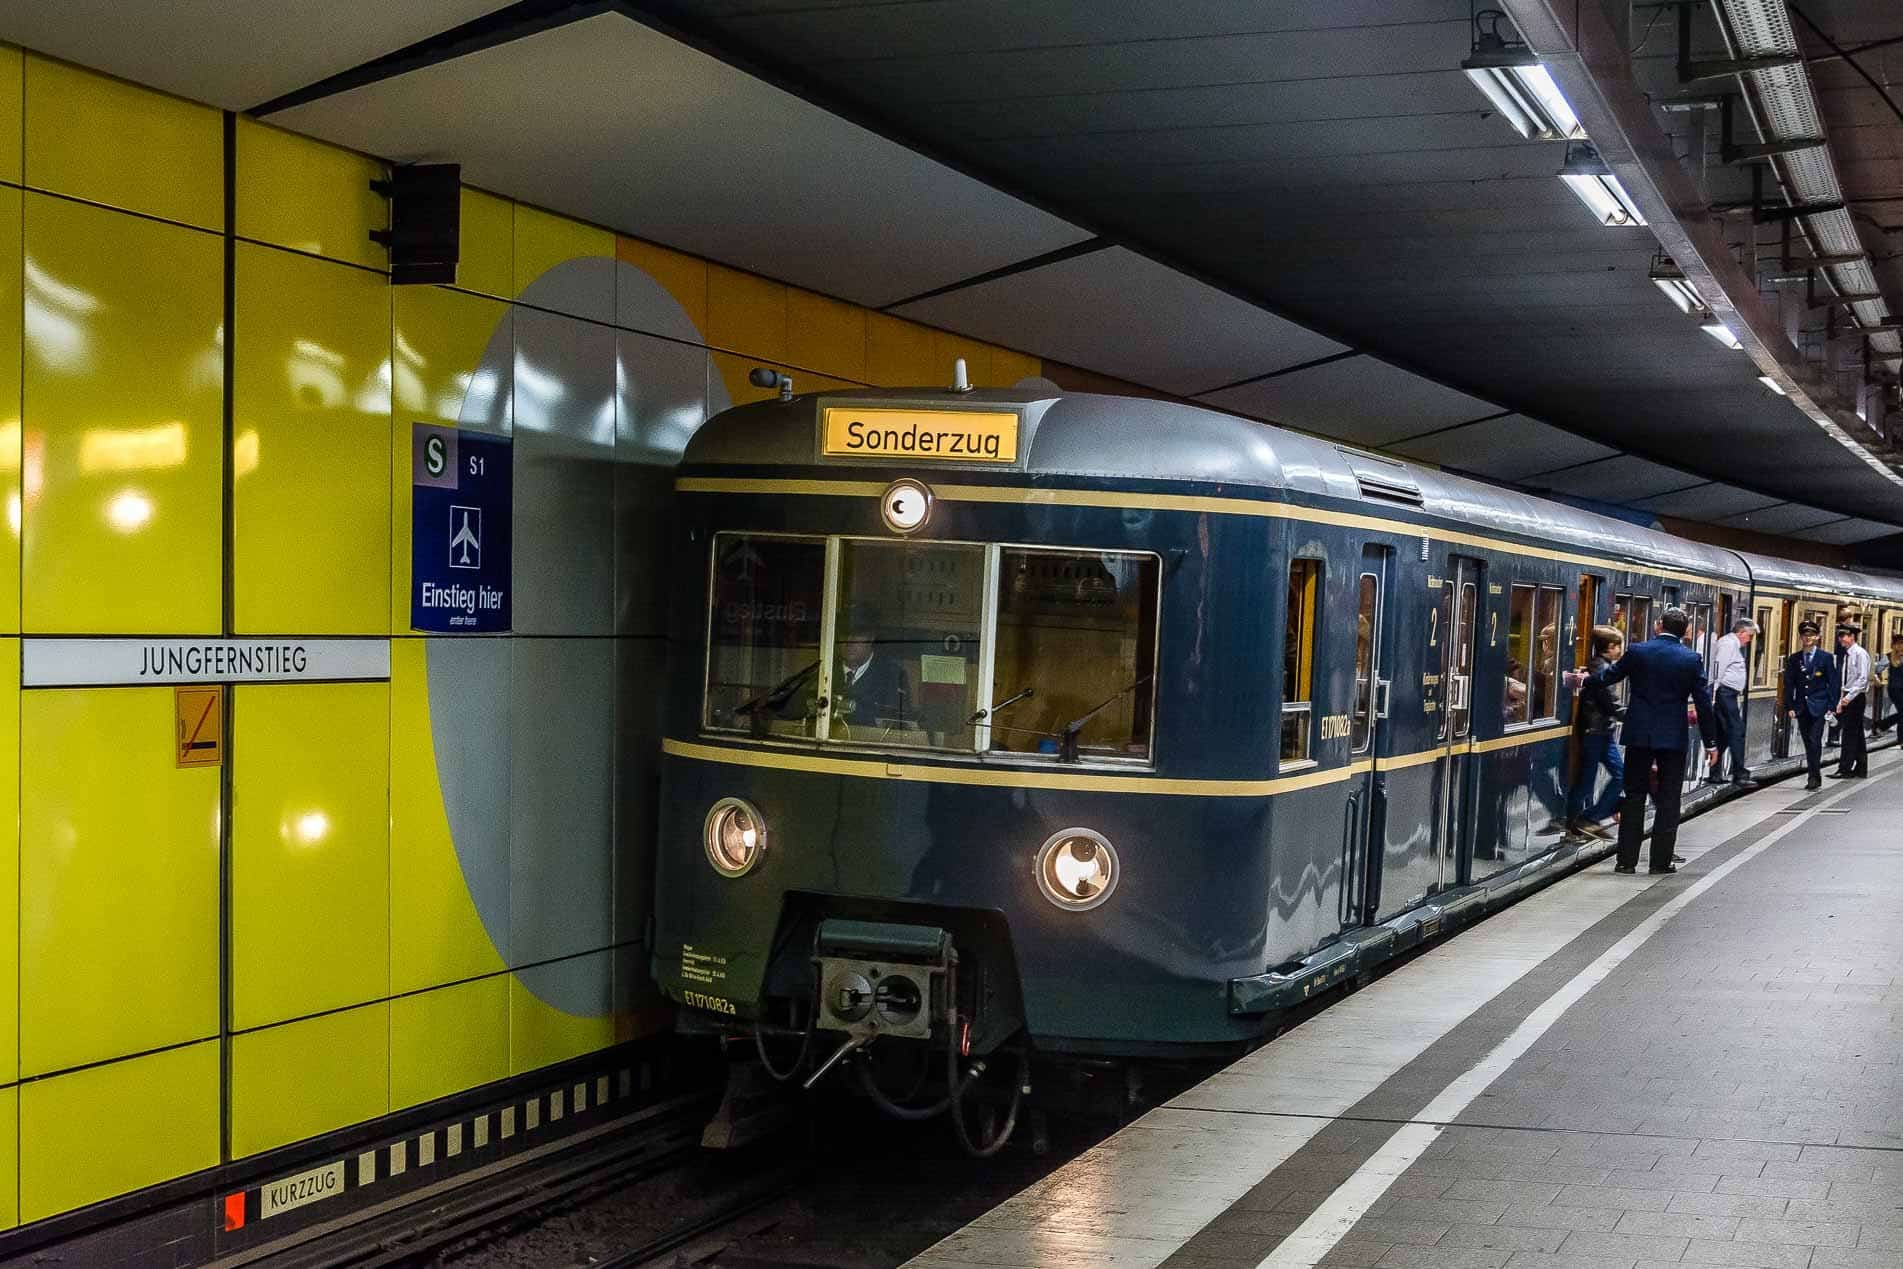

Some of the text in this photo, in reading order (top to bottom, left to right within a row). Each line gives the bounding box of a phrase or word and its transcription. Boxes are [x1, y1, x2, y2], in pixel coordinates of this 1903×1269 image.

[427, 437, 444, 473] S
[846, 421, 1001, 458] Sonderzug
[422, 582, 504, 614] Einstieg hier
[1429, 607, 1438, 647] 2
[1490, 611, 1497, 647] 2
[1567, 615, 1575, 647] 2
[140, 646, 307, 675] JUNGFERNSTIEG
[271, 1171, 336, 1209] KURZZUG
